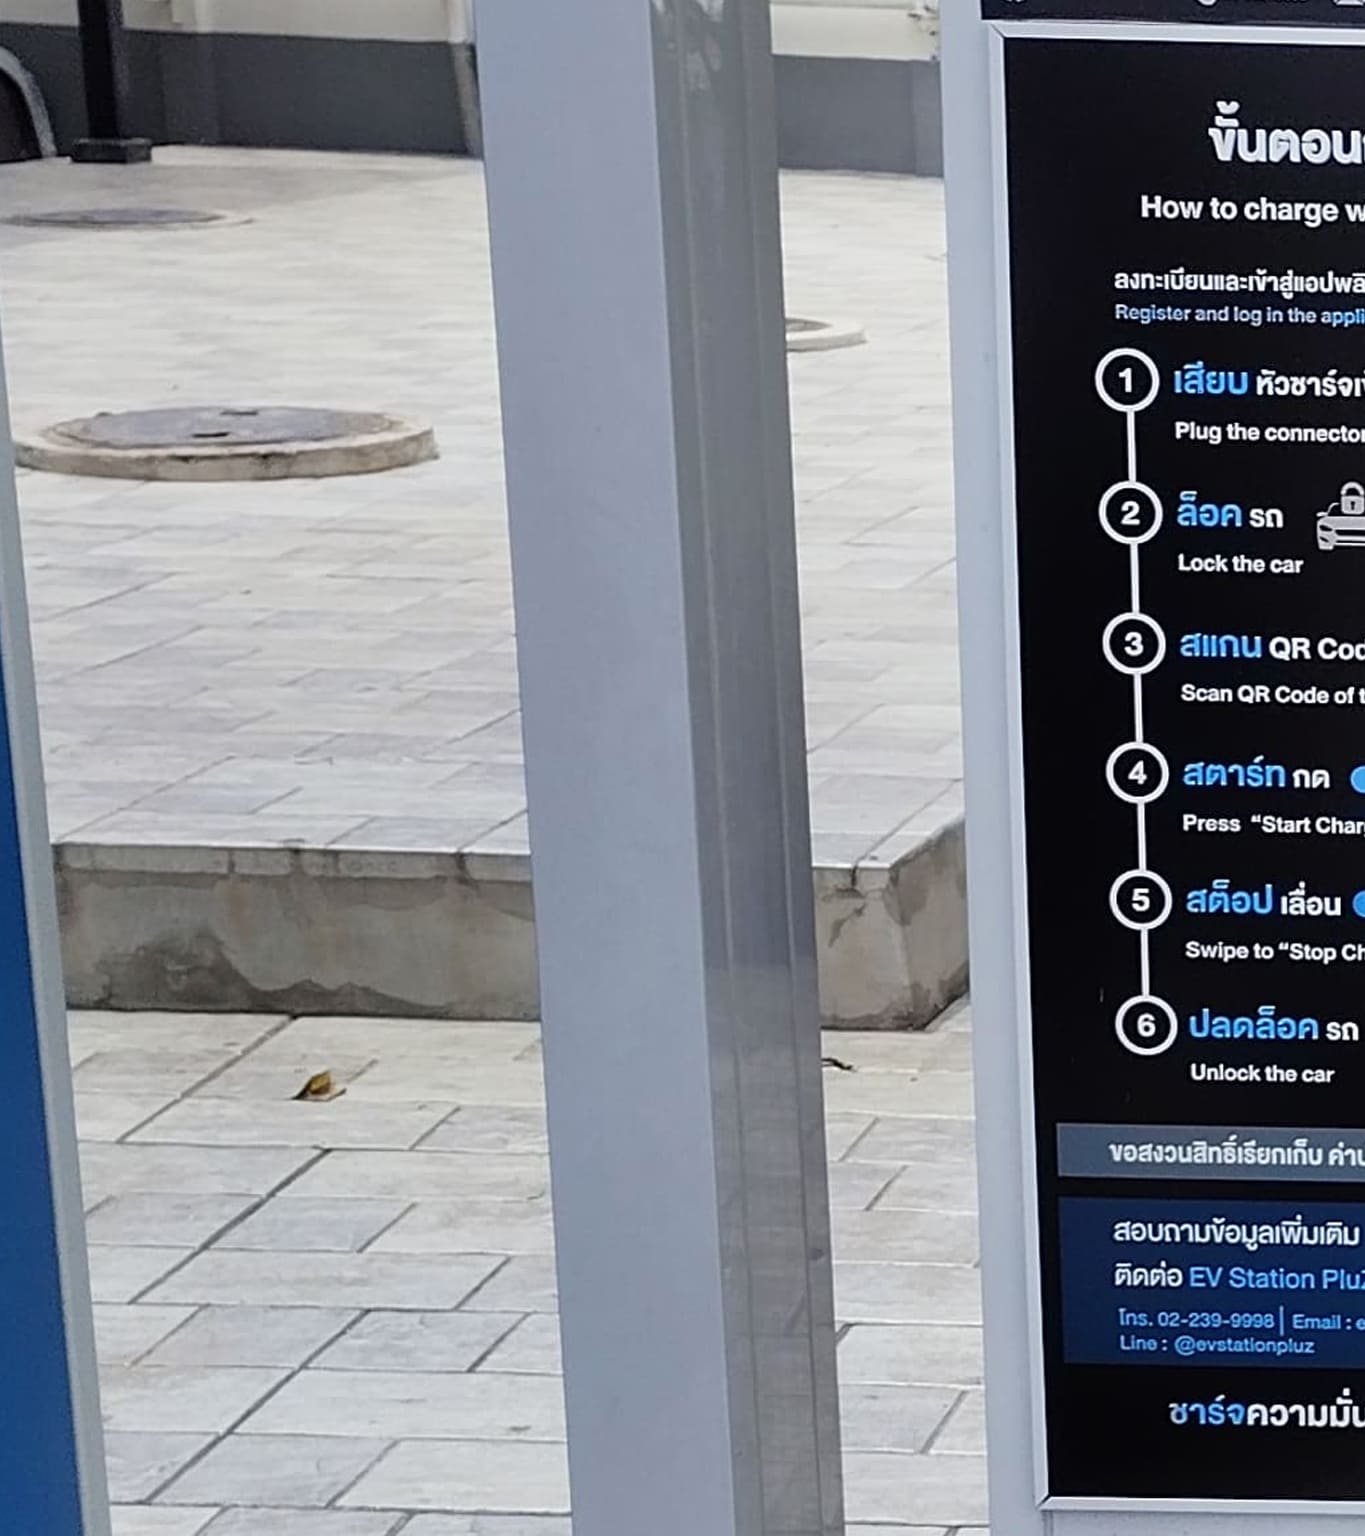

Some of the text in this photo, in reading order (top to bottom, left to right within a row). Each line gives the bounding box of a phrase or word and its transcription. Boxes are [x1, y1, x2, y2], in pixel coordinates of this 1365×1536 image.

[1142, 196, 1203, 218] How
[1210, 198, 1237, 219] to
[1244, 197, 1338, 227] charge
[1116, 304, 1191, 324] Register
[1195, 306, 1229, 321] and
[1234, 306, 1262, 326] log
[1267, 307, 1283, 322] in
[1288, 308, 1316, 323] the
[1119, 368, 1131, 392] 1
[1175, 361, 1248, 394] เสียบ
[1176, 422, 1221, 444] Plug
[1226, 423, 1260, 440] the
[1122, 491, 1283, 527] 2 ล็อค รถ
[1179, 554, 1303, 573] Lock the car
[1125, 632, 1143, 656] 3
[1181, 633, 1261, 658] สแกน
[1269, 637, 1311, 660] QR
[1181, 684, 1232, 702] Scan
[1238, 685, 1270, 703] QR
[1275, 686, 1329, 703] Code
[1334, 687, 1354, 703] of
[1128, 755, 1329, 788] 4 สตาร์ท กด
[1183, 814, 1241, 832] Press
[1251, 815, 1311, 833] “Start
[1132, 879, 1341, 915] 5 สต็อป เลื่อน
[1186, 941, 1249, 962] Swipe
[1253, 943, 1274, 959] to
[1279, 943, 1336, 964] “Stop
[1138, 1006, 1358, 1040] 6 ปลดล็อค รถ
[1191, 1064, 1335, 1082] Unlock the car
[1110, 1135, 1322, 1165] ขอสงวนสิทธิ์เรียกเก็บ
[1114, 1215, 1359, 1250] สอบถามข้อมูลเพิ่มเติม
[1115, 1261, 1182, 1286] ติดต่อ
[1190, 1267, 1222, 1287] EV
[1229, 1267, 1314, 1288] Station
[1119, 1308, 1152, 1326] โทร.
[1158, 1312, 1274, 1328] 02-239-9998
[1293, 1314, 1341, 1329] Email
[1120, 1335, 1157, 1350] Line
[1174, 1335, 1316, 1356] @evstationpluz
